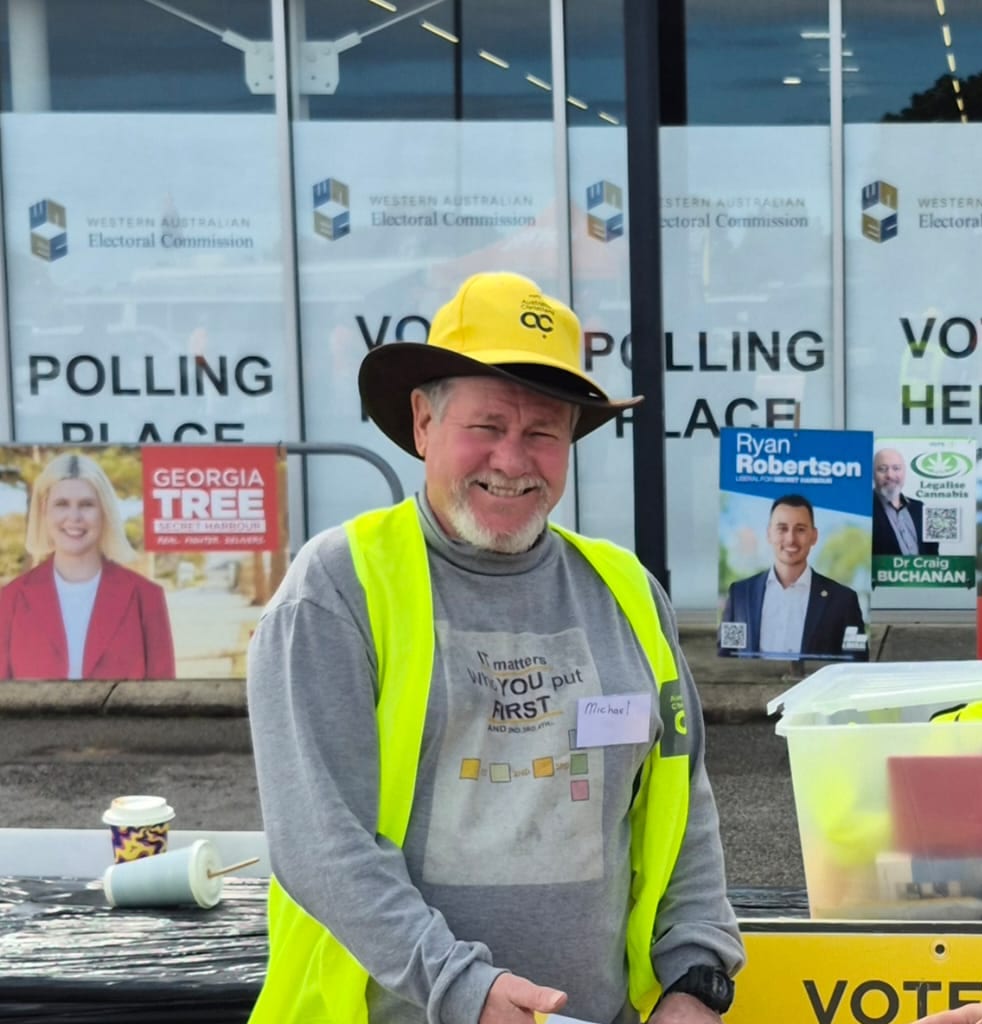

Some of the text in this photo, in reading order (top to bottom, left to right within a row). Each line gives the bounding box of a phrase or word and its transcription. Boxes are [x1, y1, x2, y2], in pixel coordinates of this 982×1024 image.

[369, 195, 533, 206] WESTERN AUSTRALIAN
[660, 197, 805, 208] STERN AUSTRALIAN
[87, 217, 250, 227] WESTERN AUSTRALIAN
[371, 212, 536, 227] Electoral Commission
[660, 213, 808, 228] ectoral Commission
[88, 233, 253, 248] Electoral Commission
[355, 315, 430, 350] VO
[584, 330, 825, 372] PLLING
[28, 354, 273, 396] POLLING
[737, 433, 790, 456] Ryan
[736, 455, 861, 477] Robertson
[153, 468, 264, 487] GEORGIA
[920, 480, 966, 490] Legalise
[915, 490, 968, 498] Cannabis
[153, 488, 264, 519] TREE
[893, 557, 949, 570] Dr Craig
[877, 570, 966, 583] BUCHANAN
[493, 655, 547, 671] matters
[498, 672, 544, 696] YOU
[552, 669, 583, 691] put
[492, 696, 550, 721] FIRST
